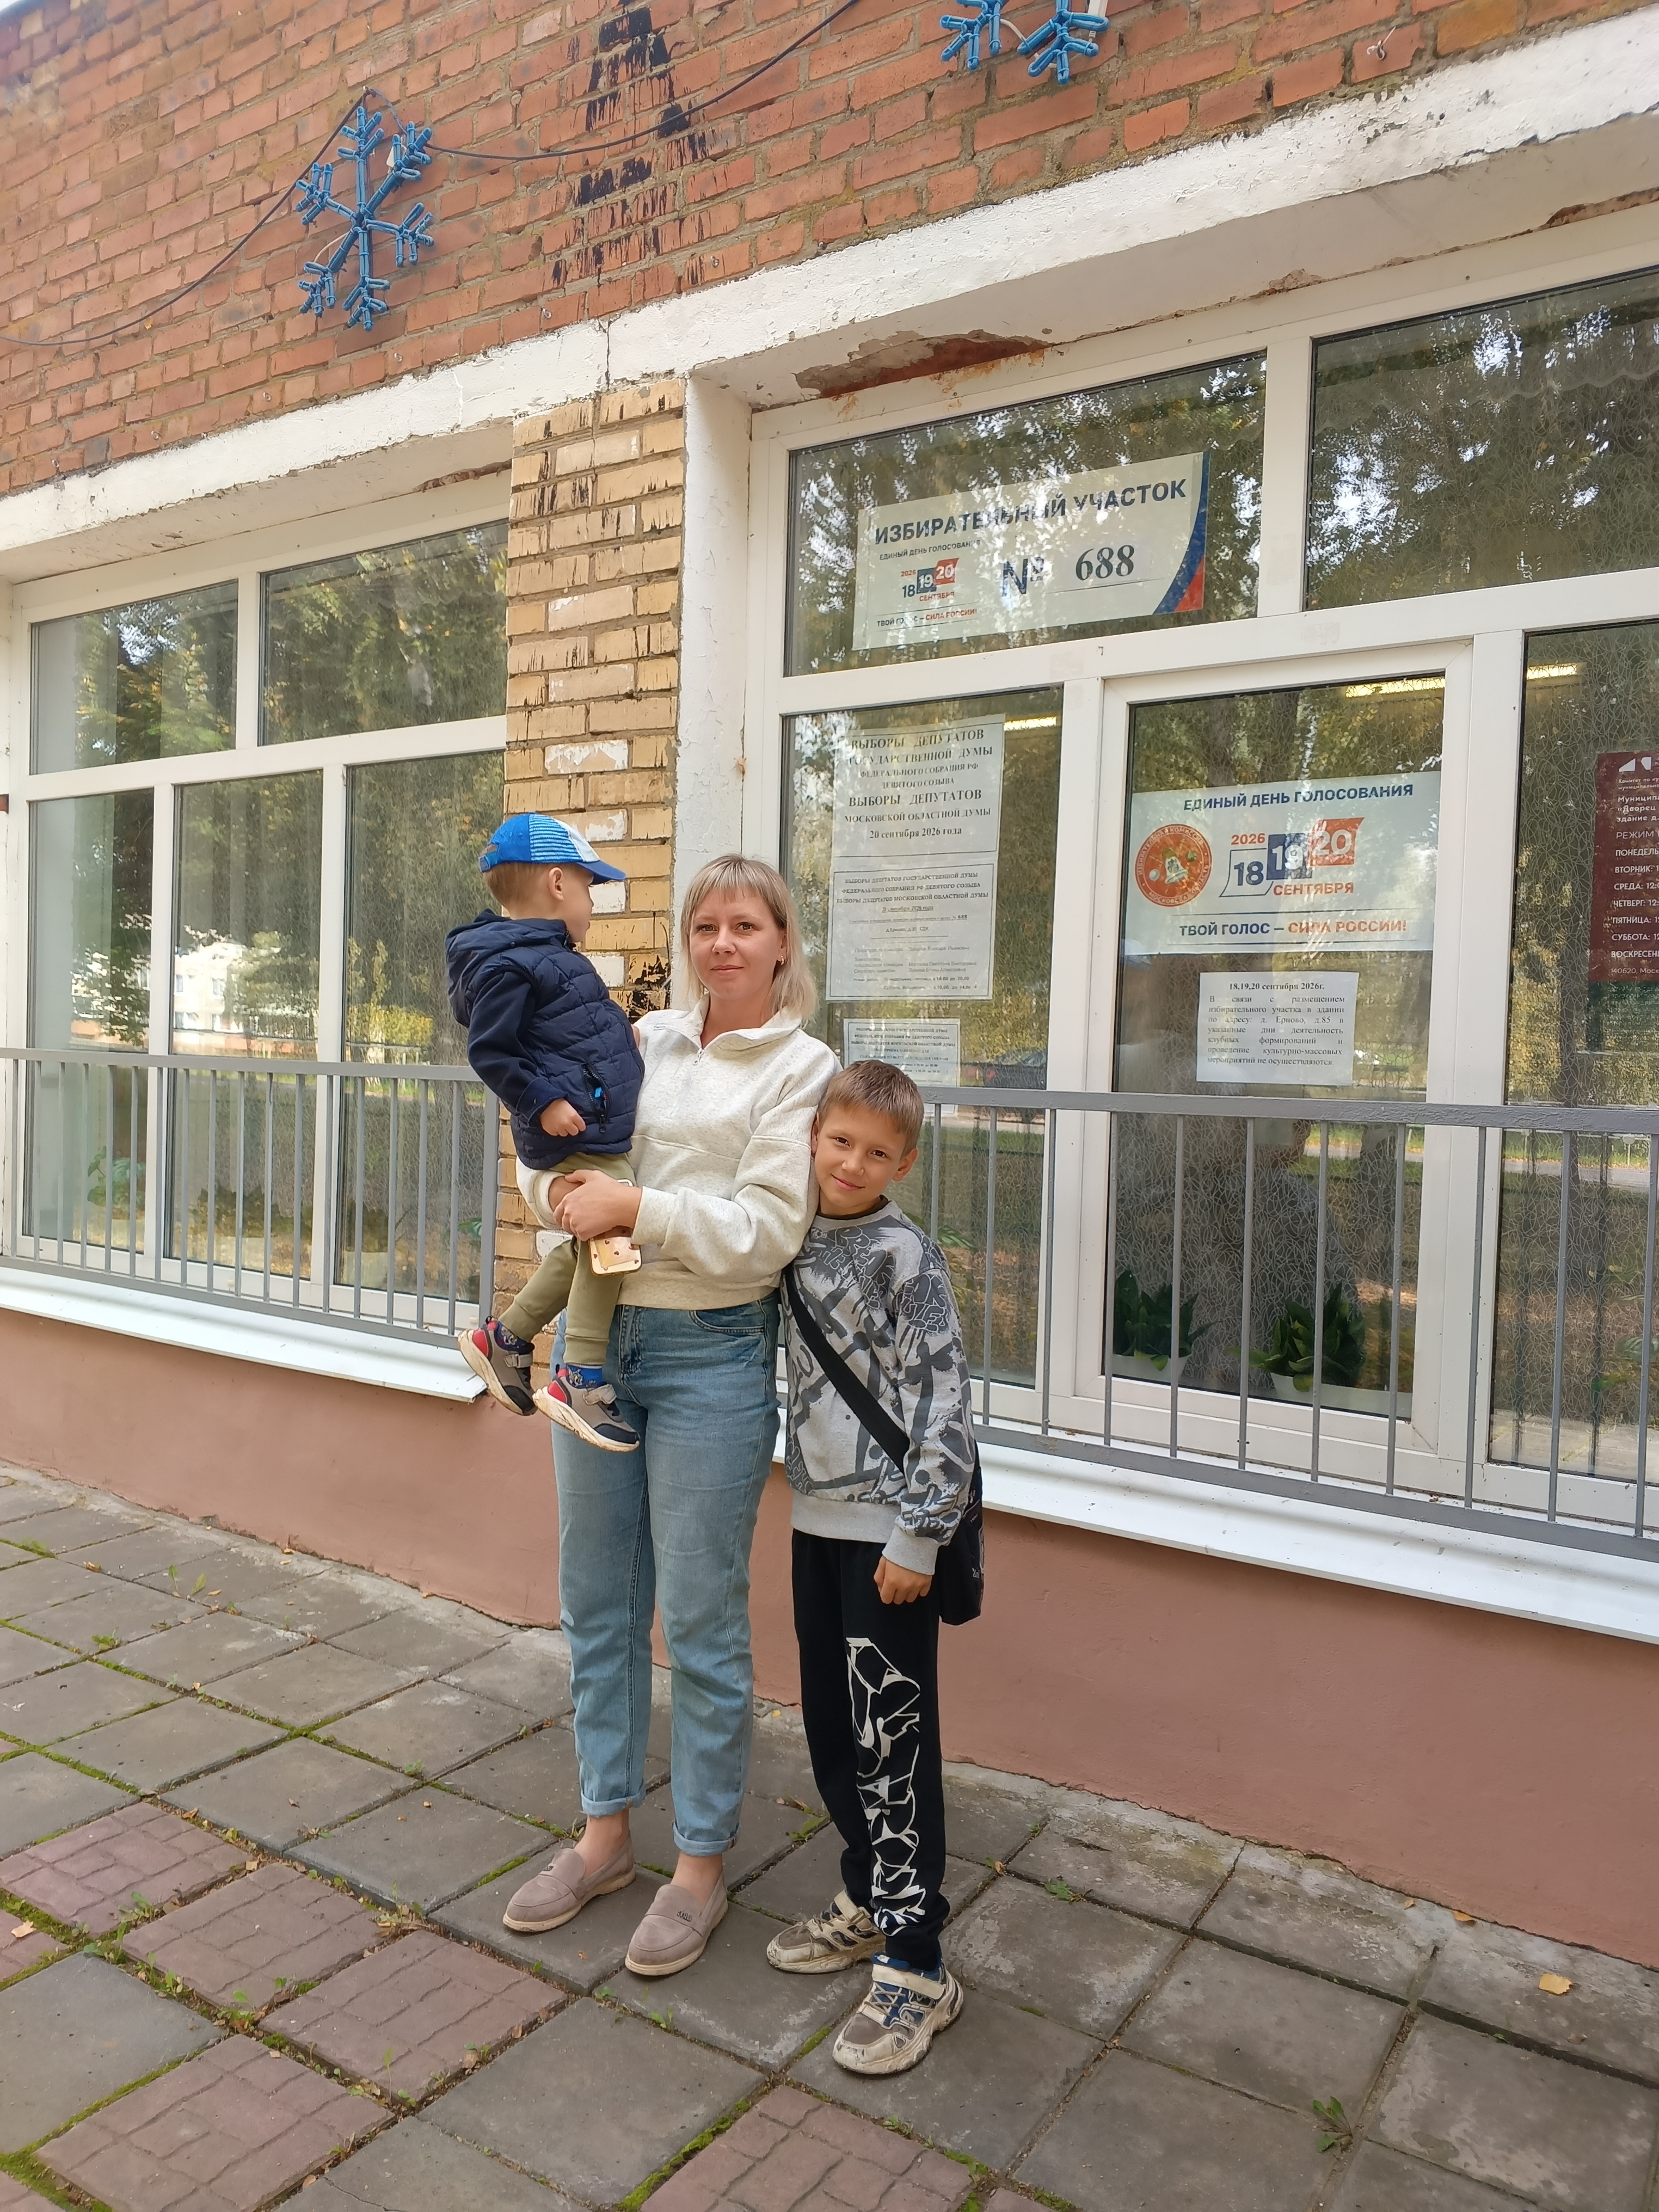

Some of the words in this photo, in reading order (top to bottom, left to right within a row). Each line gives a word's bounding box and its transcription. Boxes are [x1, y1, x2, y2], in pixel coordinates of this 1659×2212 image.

[1073, 478, 1187, 512] УЧАСТОК
[880, 550, 908, 560] ЕДИНЫЙ
[909, 548, 927, 556] ДЕНЬ
[929, 540, 980, 553] ГОЛОСОВАНИЯ
[1001, 556, 1044, 597] №
[1075, 544, 1135, 581] 688
[902, 584, 915, 598] 18
[918, 574, 934, 588] 19
[936, 563, 954, 580] 20
[919, 591, 955, 601] СЕНТЯБРЯ
[877, 617, 895, 626] ТВОЙ
[896, 616, 918, 626] ГОС
[925, 612, 945, 620] СИЛА
[945, 609, 977, 618] РОССИИ!
[851, 738, 905, 750] ВЫБОРЫ
[913, 729, 984, 748] ДЕПУТАТОВ
[848, 748, 951, 765] ГОСУДАРСТВЕННОЙ
[958, 746, 993, 759] ДУМЫ
[924, 763, 965, 775] СОБРАНИЯ
[924, 778, 954, 787] СОЗЫВА
[849, 795, 901, 807] ВЫБОРЫ
[910, 789, 982, 805] ДЕПУТАТОВ
[1183, 793, 1247, 810] ЕДИНЫЙ
[1250, 791, 1290, 807] ДЕНЬ
[1294, 784, 1414, 803] ГОЛОСОВАНИЯ
[845, 812, 905, 822] МОСКОВСКОЙ
[908, 808, 960, 821] ОБЛАСТНОЙ
[962, 808, 991, 818] ДУМЫ
[869, 830, 880, 839] 20
[881, 828, 919, 839] сентября
[921, 827, 941, 837] 2026
[1231, 833, 1265, 845] 2026
[1616, 830, 1654, 839] РЕЖИМ
[1233, 859, 1264, 886] 18
[1271, 844, 1303, 870] 19
[1312, 829, 1352, 856] 20
[1615, 847, 1659, 857] ПОНЕДЕЛЬ
[1614, 865, 1654, 874] ВТОРНИК:
[1273, 882, 1354, 896] СЕНТЯБРЯ
[1614, 882, 1644, 890] СРЕДА:
[1613, 899, 1646, 907] ЧЕТВЕРГ:
[1612, 917, 1652, 925] ПЯТНИЦА:
[1179, 922, 1218, 936] ТВОЙ
[1221, 923, 1270, 936] ГОЛОС
[1288, 921, 1331, 935] СИЛА
[1336, 920, 1406, 933] РОССИИ!
[1230, 982, 1260, 991] 18,19,20
[1262, 983, 1299, 991] сентября
[1301, 982, 1325, 991] 2026г.
[1208, 1005, 1267, 1015] избирательного
[1276, 1016, 1306, 1024] Ерново,
[1259, 1036, 1316, 1044] формирований
[1207, 1056, 1255, 1065] мероприятий
